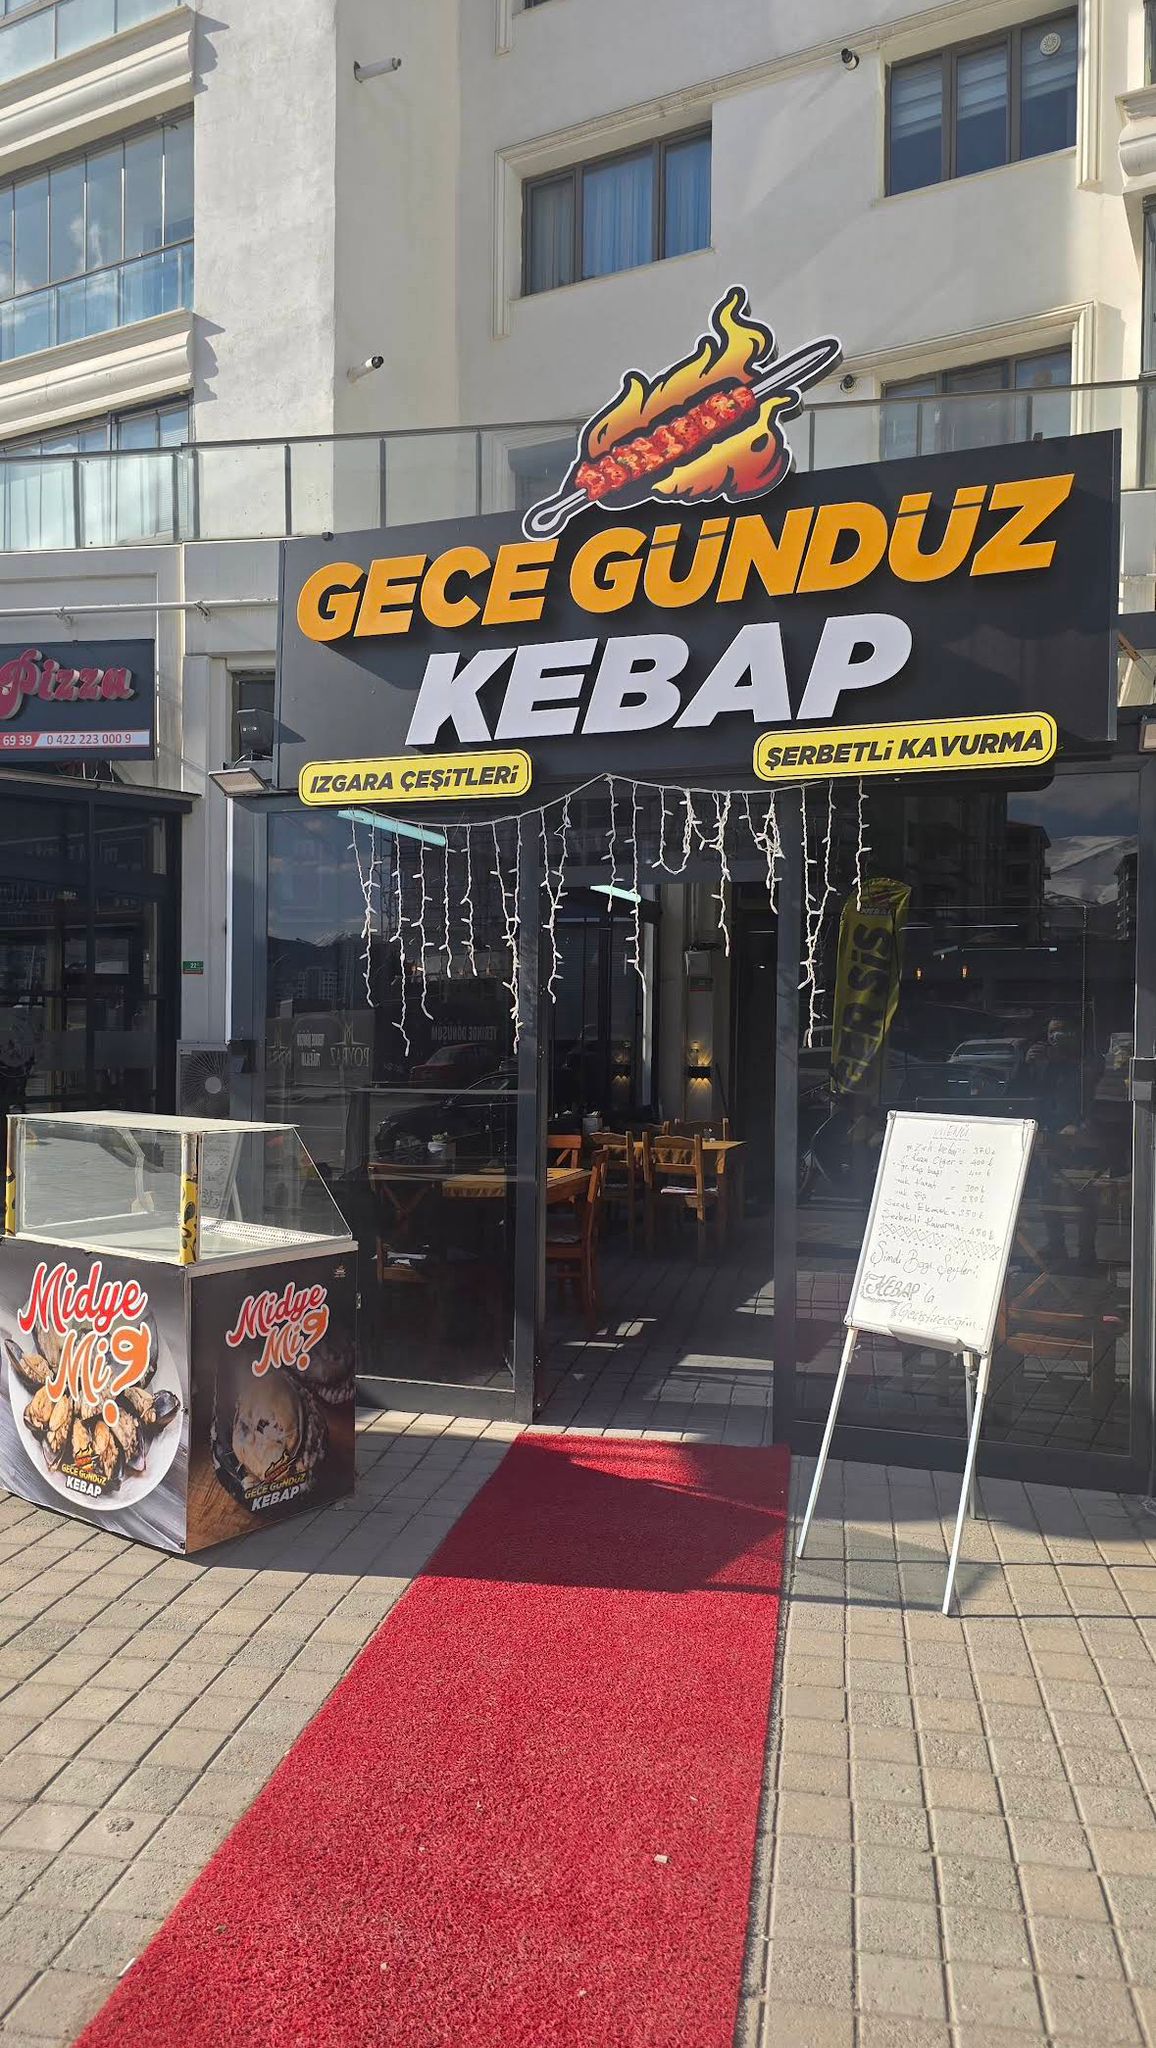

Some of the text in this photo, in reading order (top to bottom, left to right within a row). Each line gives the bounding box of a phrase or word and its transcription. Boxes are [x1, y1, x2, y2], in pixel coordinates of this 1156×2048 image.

[297, 473, 1075, 641] GECE GÜNDÜZ
[0, 649, 134, 719] Pizza
[405, 612, 913, 747] KEBAP
[3, 735, 32, 746] 69 39
[57, 734, 76, 745] 422
[80, 734, 98, 745] 223
[102, 733, 122, 744] 000
[764, 729, 1043, 771] ŞERBETLİ KAVURMA
[310, 772, 393, 793] IZGARA
[18, 1261, 148, 1335] Midye
[226, 1281, 328, 1347] Midye
[61, 1462, 79, 1477] GECE
[66, 1476, 102, 1498] KEBAP
[244, 1484, 269, 1500] GECE
[251, 1486, 300, 1512] KEBAP
